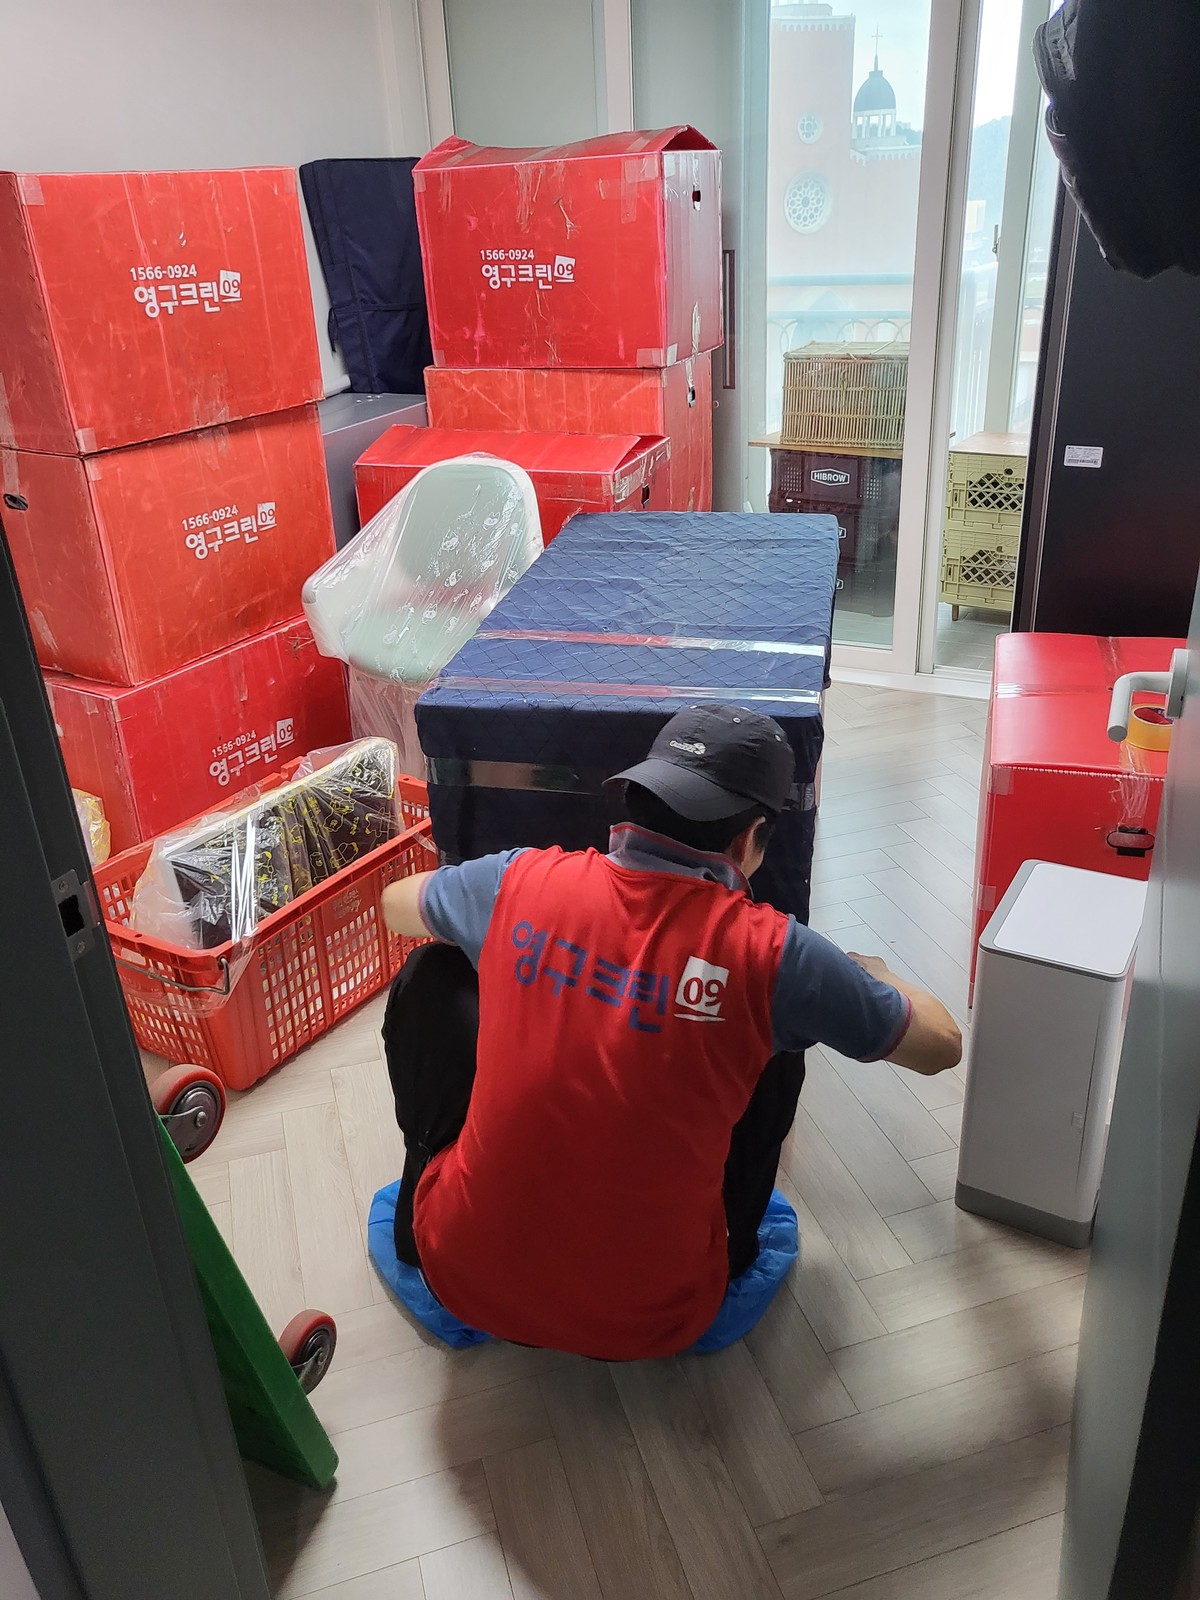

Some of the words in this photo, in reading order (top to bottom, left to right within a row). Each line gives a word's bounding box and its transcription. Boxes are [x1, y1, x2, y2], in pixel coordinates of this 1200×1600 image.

[480, 249, 534, 260] 1566-0924
[130, 264, 197, 281] 1566-0924
[481, 264, 553, 290] 영구크린
[134, 281, 220, 318] 영구크린
[813, 472, 846, 483] HIBROW
[182, 504, 238, 531] 1566-0924
[185, 514, 258, 560] 영구크린
[209, 733, 278, 786] 영구크린
[511, 919, 670, 1034] 영구크린
[682, 975, 726, 1008] 09
